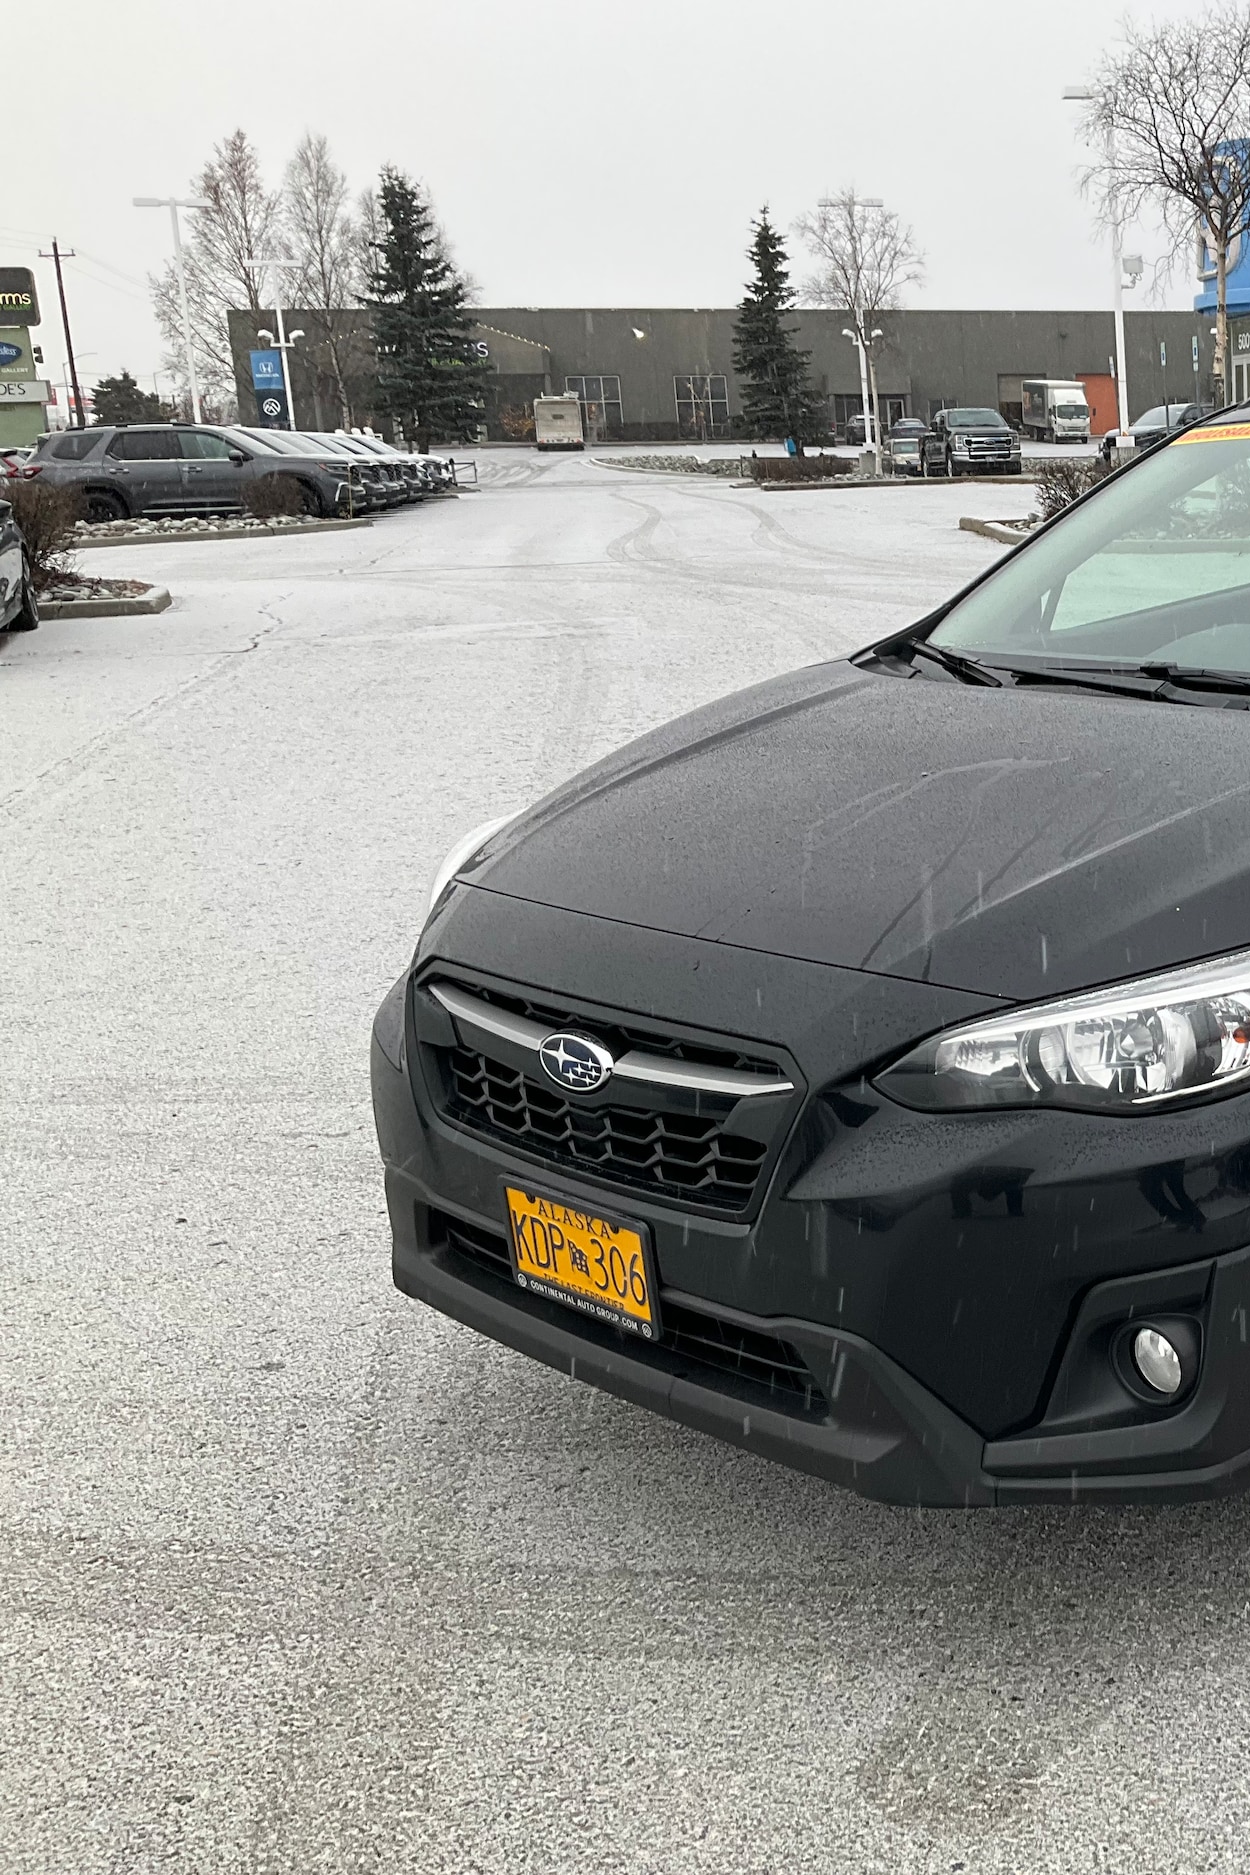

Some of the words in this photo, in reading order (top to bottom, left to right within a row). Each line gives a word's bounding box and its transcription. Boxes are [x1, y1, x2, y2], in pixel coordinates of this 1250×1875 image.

[538, 1199, 612, 1241] ALASKA
[512, 1209, 565, 1273] KDP
[590, 1238, 647, 1306] 306
[530, 1279, 577, 1306] CONTINENTAL
[577, 1298, 596, 1313] AUTO
[596, 1306, 620, 1322] GROUP
